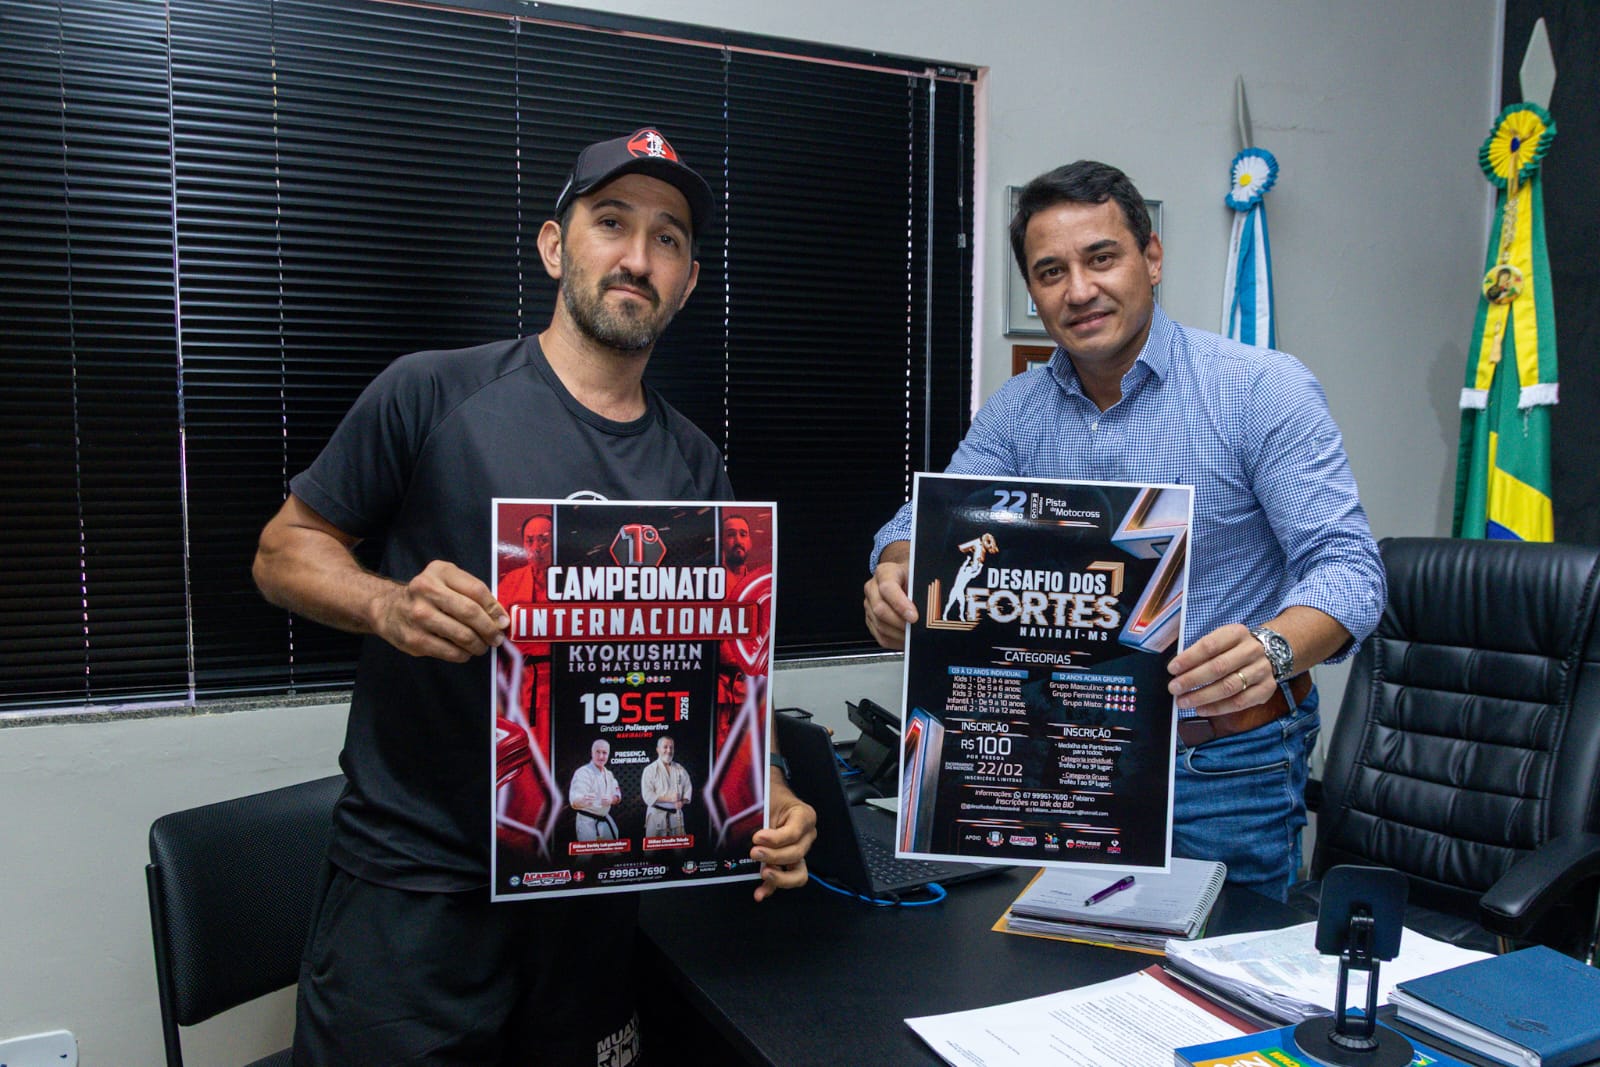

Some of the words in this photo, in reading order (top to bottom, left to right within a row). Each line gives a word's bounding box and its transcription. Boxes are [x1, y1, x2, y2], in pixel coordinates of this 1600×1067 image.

[991, 489, 1027, 512] 22
[1046, 498, 1066, 507] Pista
[1056, 508, 1100, 518] Motocross
[547, 566, 726, 600] CAMPEONATO
[987, 568, 1063, 592] DESAFIO
[1069, 572, 1106, 595] DOS
[966, 587, 1120, 629] FORTES
[519, 607, 749, 637] INTERNACIONAL
[569, 644, 702, 661] KYOKUSHIN
[1004, 651, 1071, 664] CATEGORIAS
[569, 662, 596, 672] IKO
[602, 661, 701, 671] MATSUSHIMA
[974, 668, 989, 676] ANOS
[991, 669, 1021, 677] INDIVIDUAL
[976, 676, 986, 684] De
[1103, 676, 1125, 684] GRUPOS
[1049, 682, 1069, 690] Grupo
[1070, 683, 1104, 691] Masculino:
[1052, 690, 1072, 698] Grupo
[1073, 691, 1103, 700] Feminino:
[580, 692, 619, 724] 19
[620, 691, 689, 722] SET
[680, 696, 689, 720] 2026
[1063, 700, 1082, 708] Grupo
[625, 723, 669, 732] Poliesportivo
[961, 721, 1009, 733] INSCRIÇÃO
[1063, 727, 1111, 739] INSCRIÇÃO
[961, 739, 975, 750] R$
[976, 736, 1012, 755] 100
[1089, 744, 1121, 752] Participação
[1061, 755, 1086, 763] Categoria
[977, 761, 1023, 777] 22/02
[1032, 792, 1068, 800] 99961-7690
[1073, 794, 1095, 802] Fabiano
[995, 798, 1029, 806] Inscrições
[1040, 800, 1052, 808] link
[609, 866, 666, 879] 99961-7690
